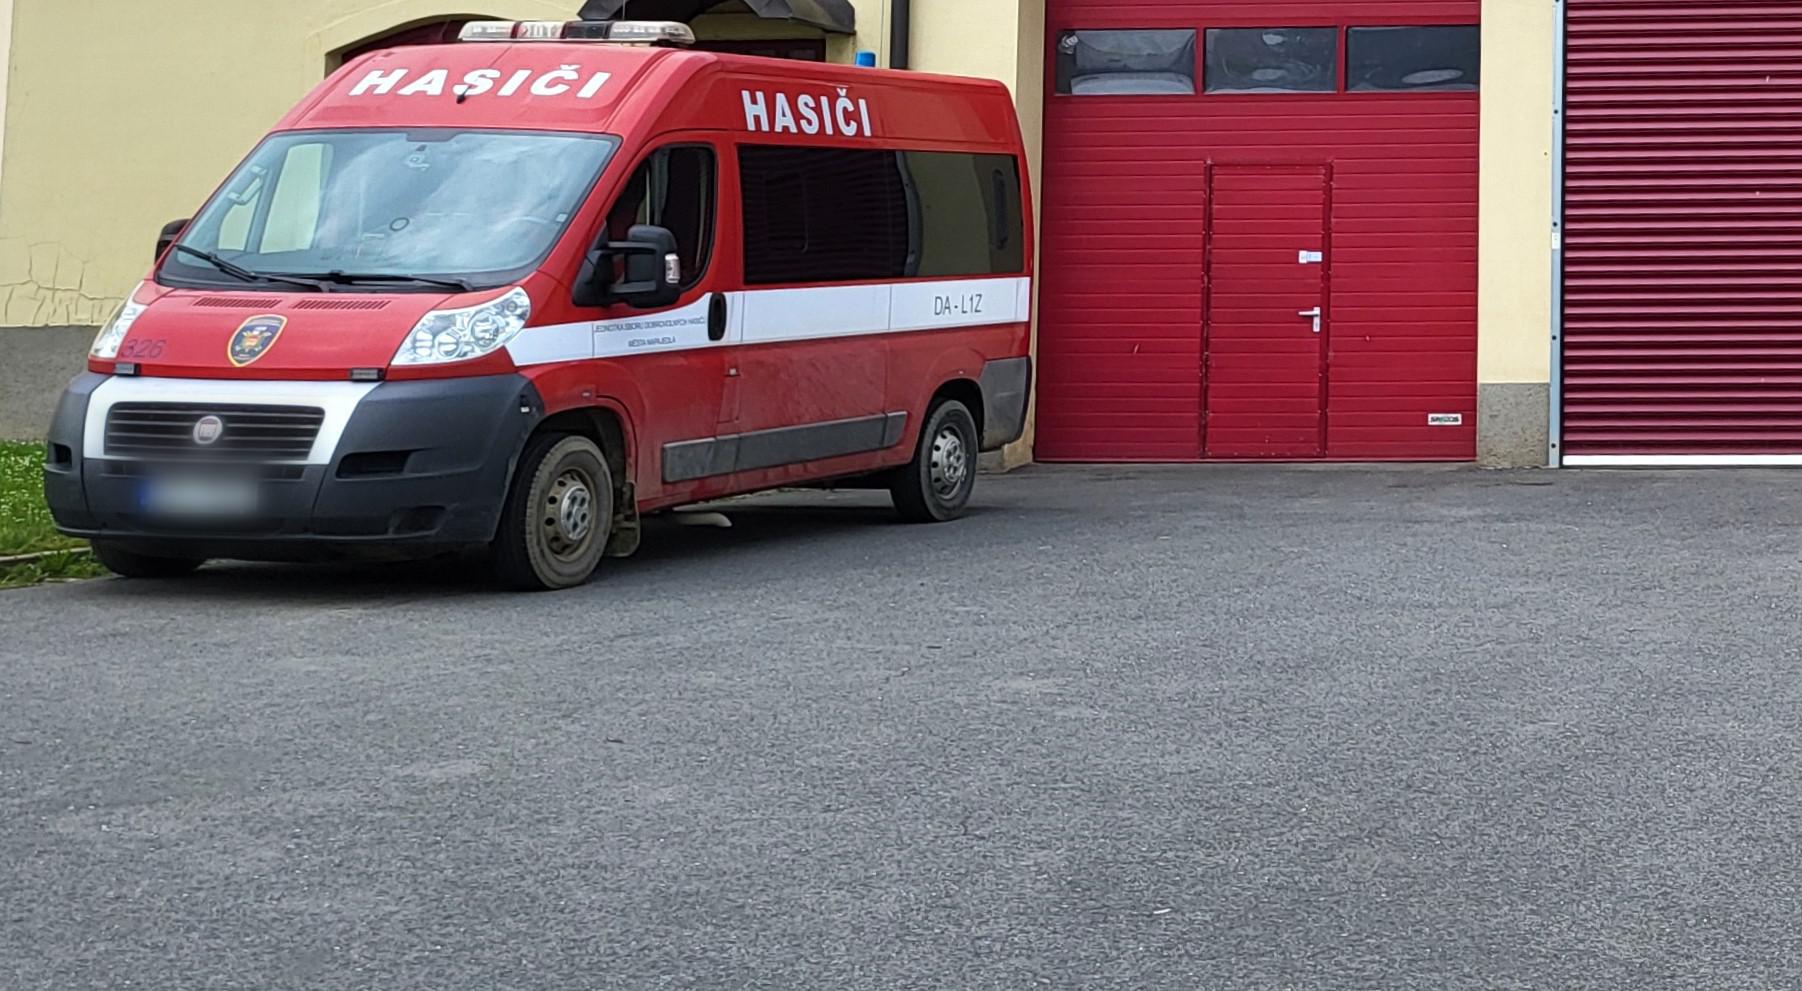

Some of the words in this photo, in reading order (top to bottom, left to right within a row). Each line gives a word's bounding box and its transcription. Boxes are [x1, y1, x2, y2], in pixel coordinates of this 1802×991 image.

[347, 64, 612, 99] HASIČI
[741, 87, 872, 137] HASIČI
[121, 338, 167, 358] 326
